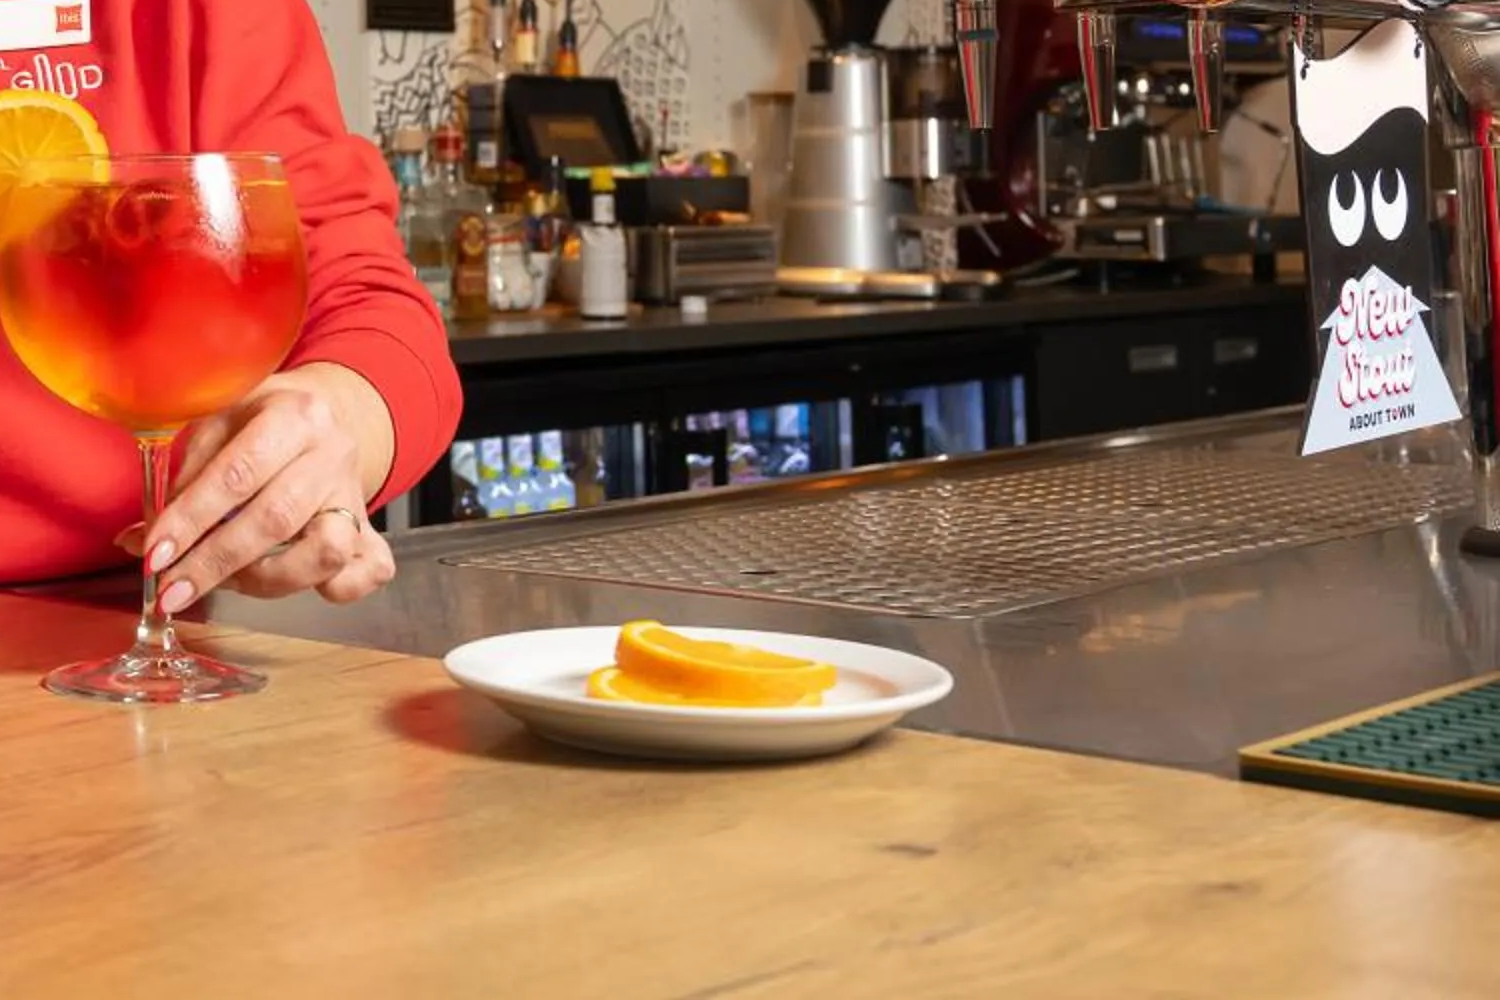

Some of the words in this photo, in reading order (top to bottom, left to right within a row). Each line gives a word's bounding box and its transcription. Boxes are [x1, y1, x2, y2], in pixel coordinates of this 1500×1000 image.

[10, 53, 103, 101] GOOD
[1335, 275, 1413, 346] New
[1349, 410, 1384, 432] ABOUT
[1386, 403, 1416, 426] TOWN
